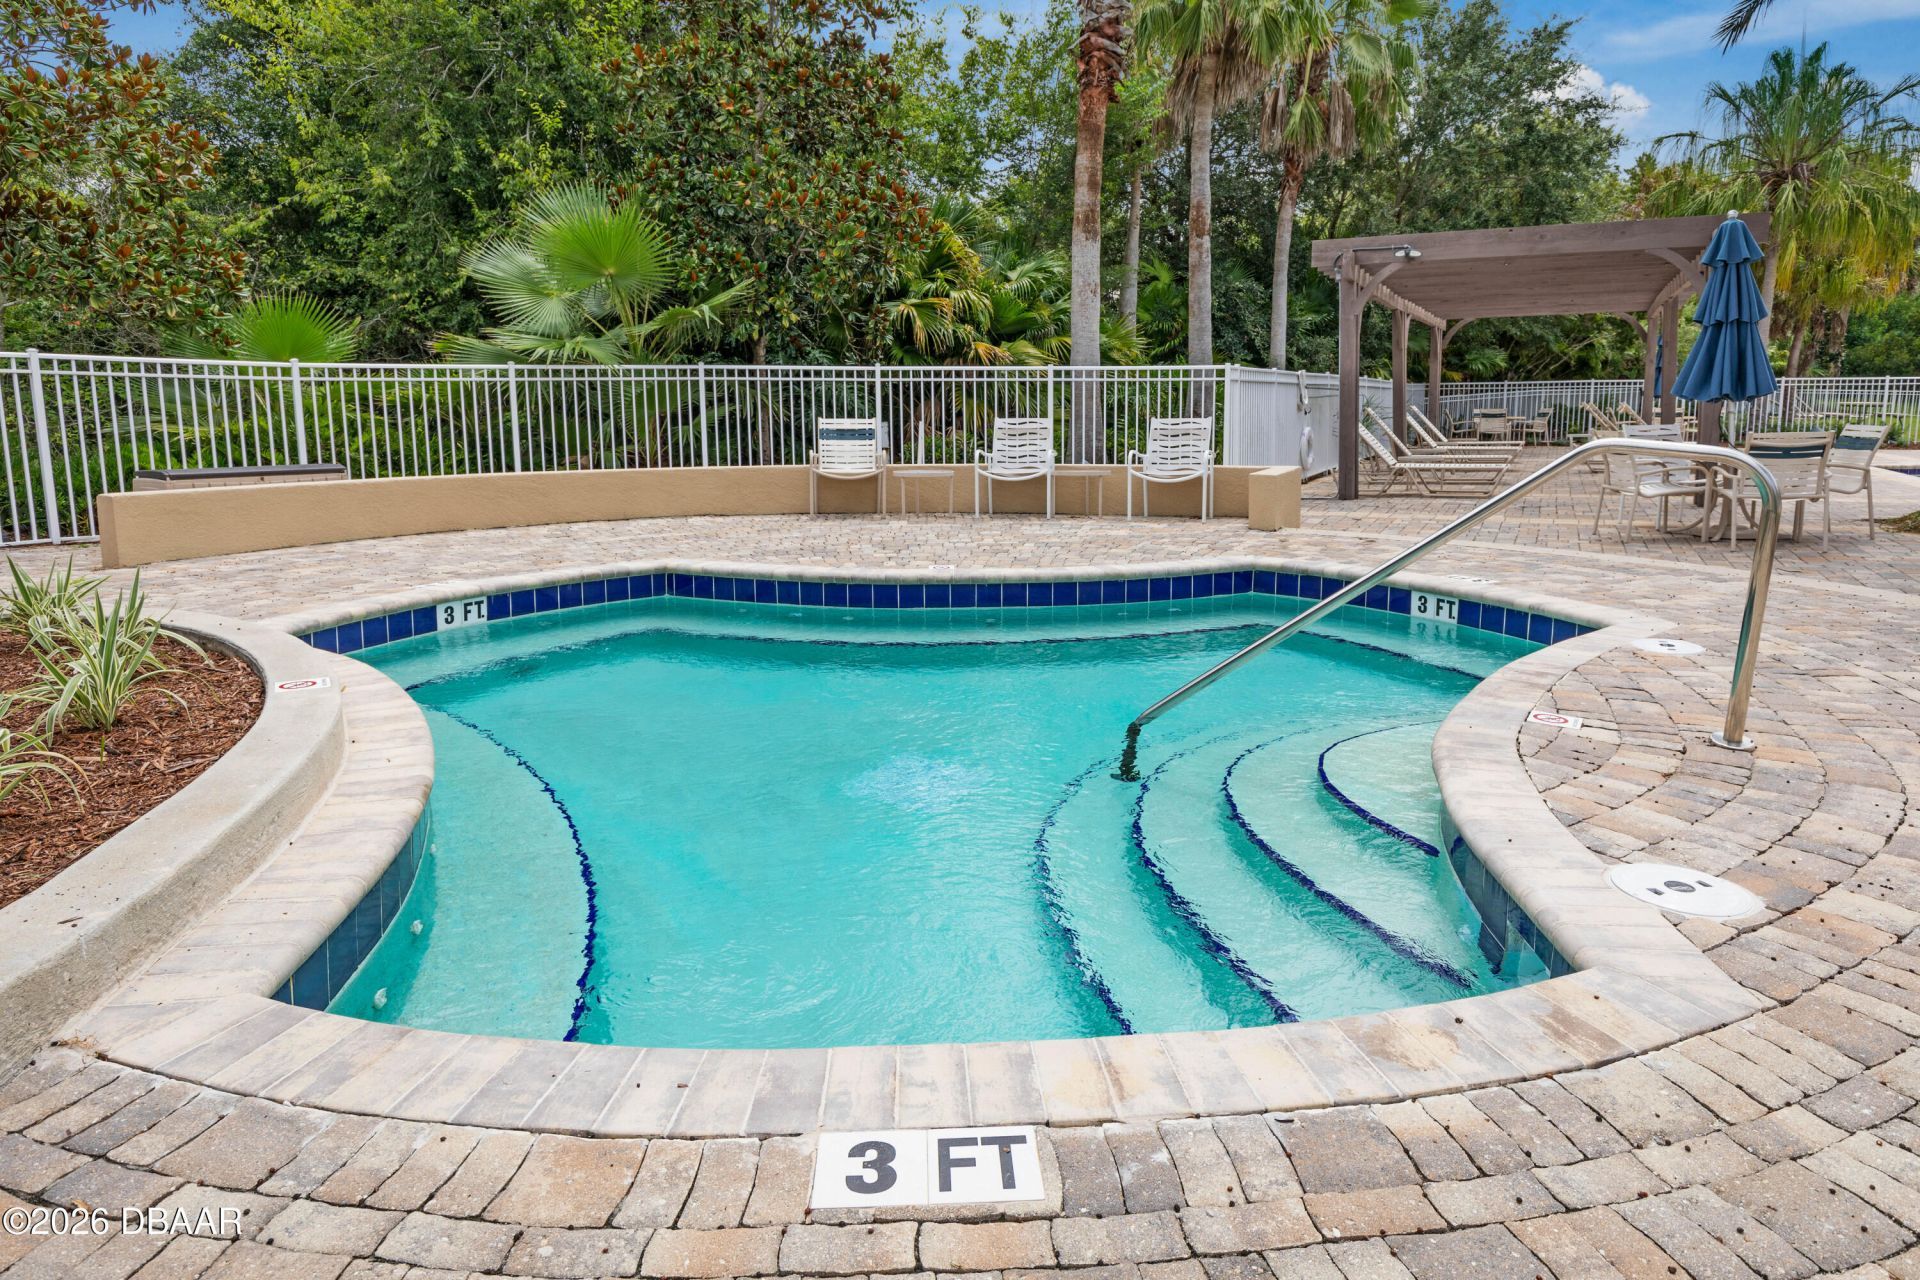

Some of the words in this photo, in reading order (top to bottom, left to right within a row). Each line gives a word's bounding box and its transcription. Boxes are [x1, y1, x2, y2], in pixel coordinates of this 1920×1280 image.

[444, 606, 454, 624] 3
[463, 600, 484, 621] FT.
[1418, 596, 1427, 613] 3
[1436, 598, 1456, 619] FT.
[845, 1140, 898, 1195] 3
[937, 1134, 1028, 1193] FT
